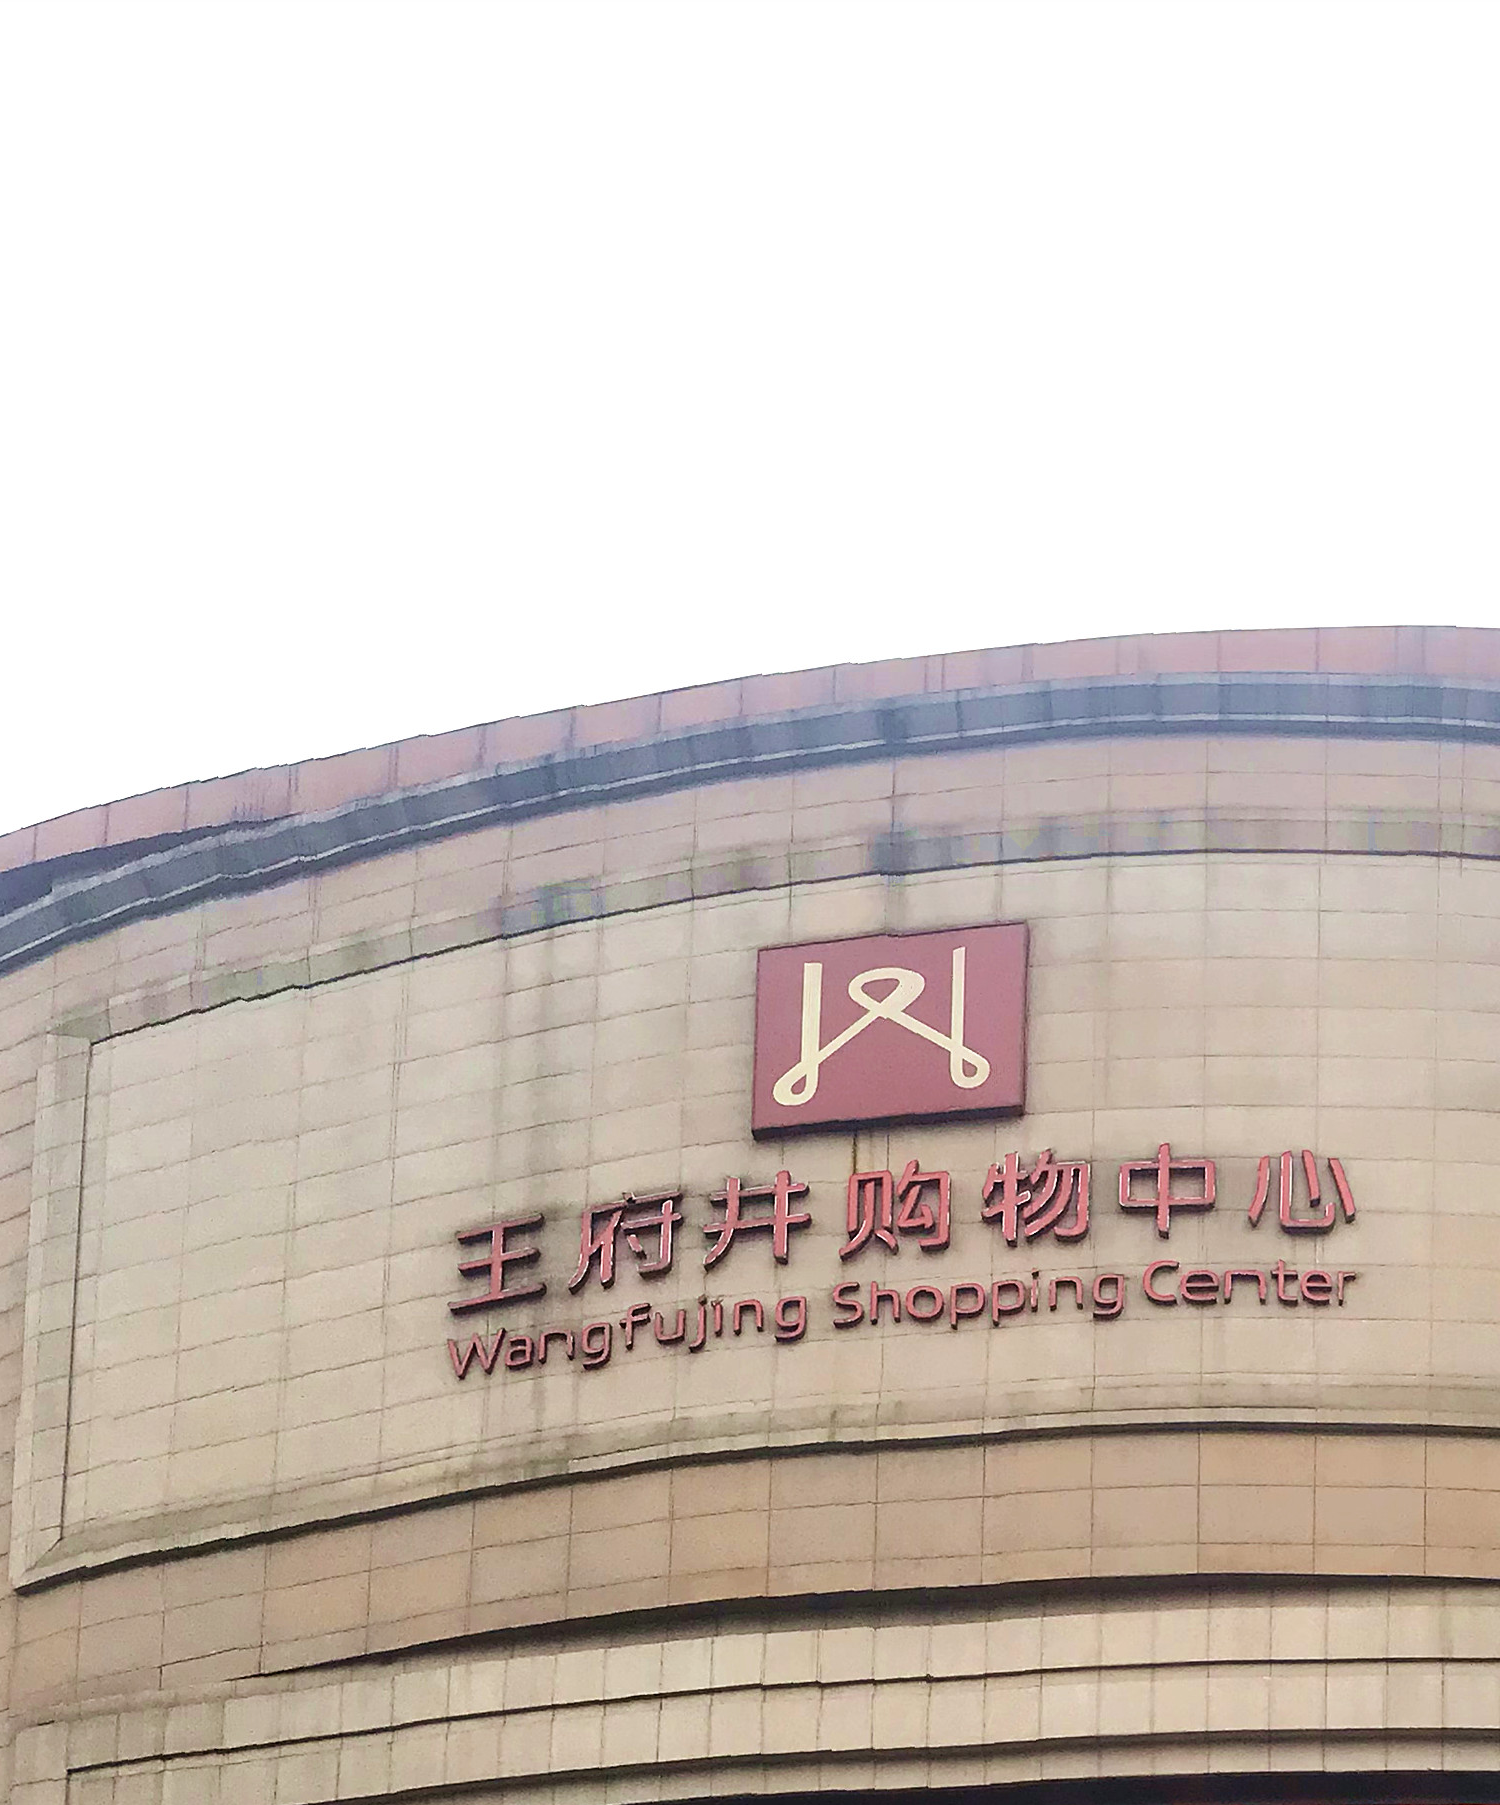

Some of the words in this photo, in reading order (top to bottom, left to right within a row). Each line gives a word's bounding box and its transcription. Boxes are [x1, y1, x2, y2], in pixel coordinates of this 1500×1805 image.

[448, 1142, 1357, 1316] 王府井购物中心
[448, 1289, 809, 1379] Wangfujing
[833, 1268, 1127, 1330] Shopping
[1141, 1257, 1357, 1307] Center
